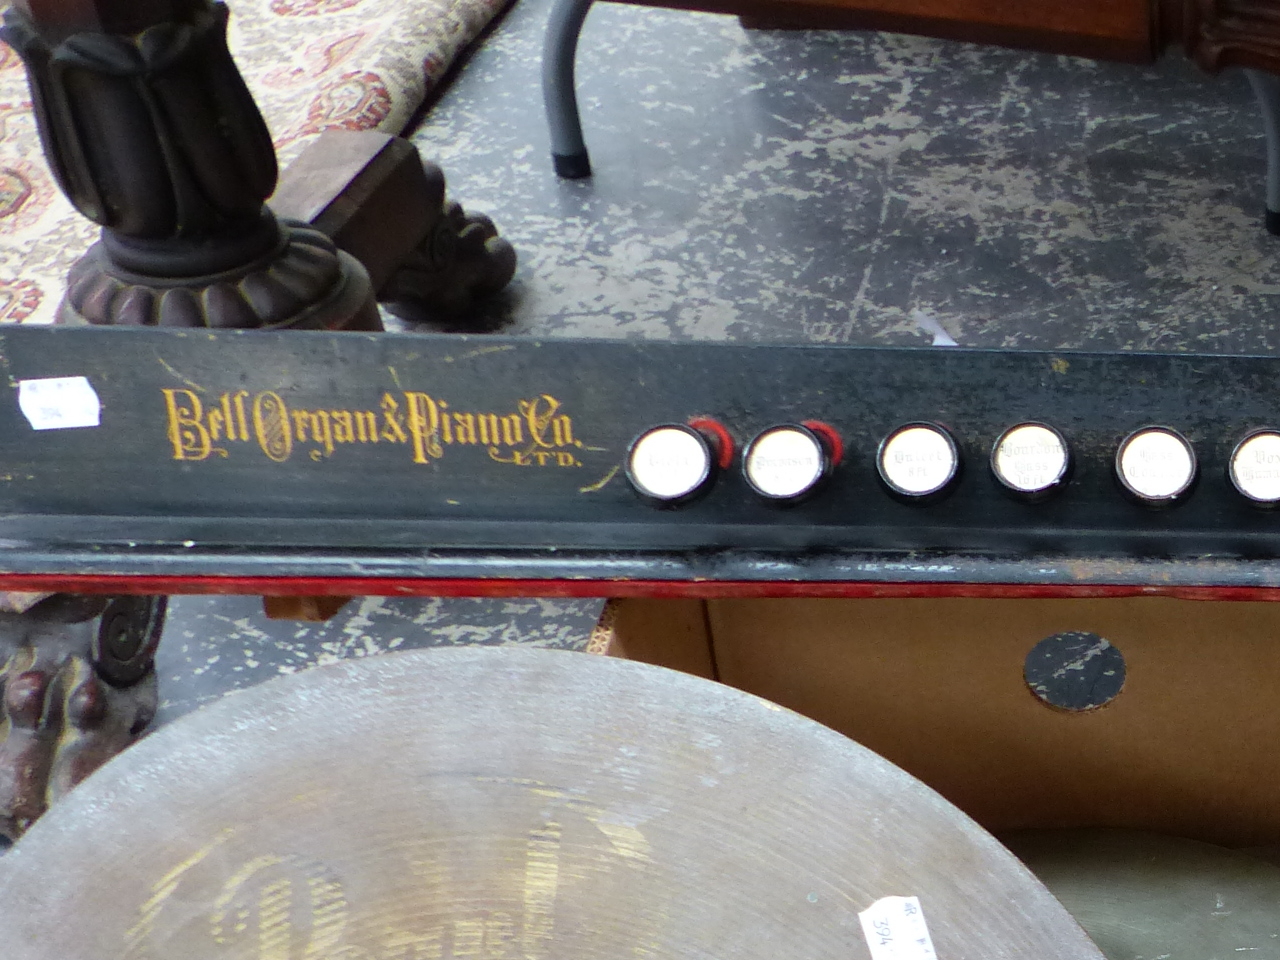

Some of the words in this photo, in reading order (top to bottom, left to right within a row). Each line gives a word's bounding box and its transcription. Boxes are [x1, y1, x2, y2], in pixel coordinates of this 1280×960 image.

[162, 388, 249, 461] Bell
[253, 390, 378, 463] Organ
[404, 391, 522, 464] Piano
[1002, 441, 1062, 458] Bourdon
